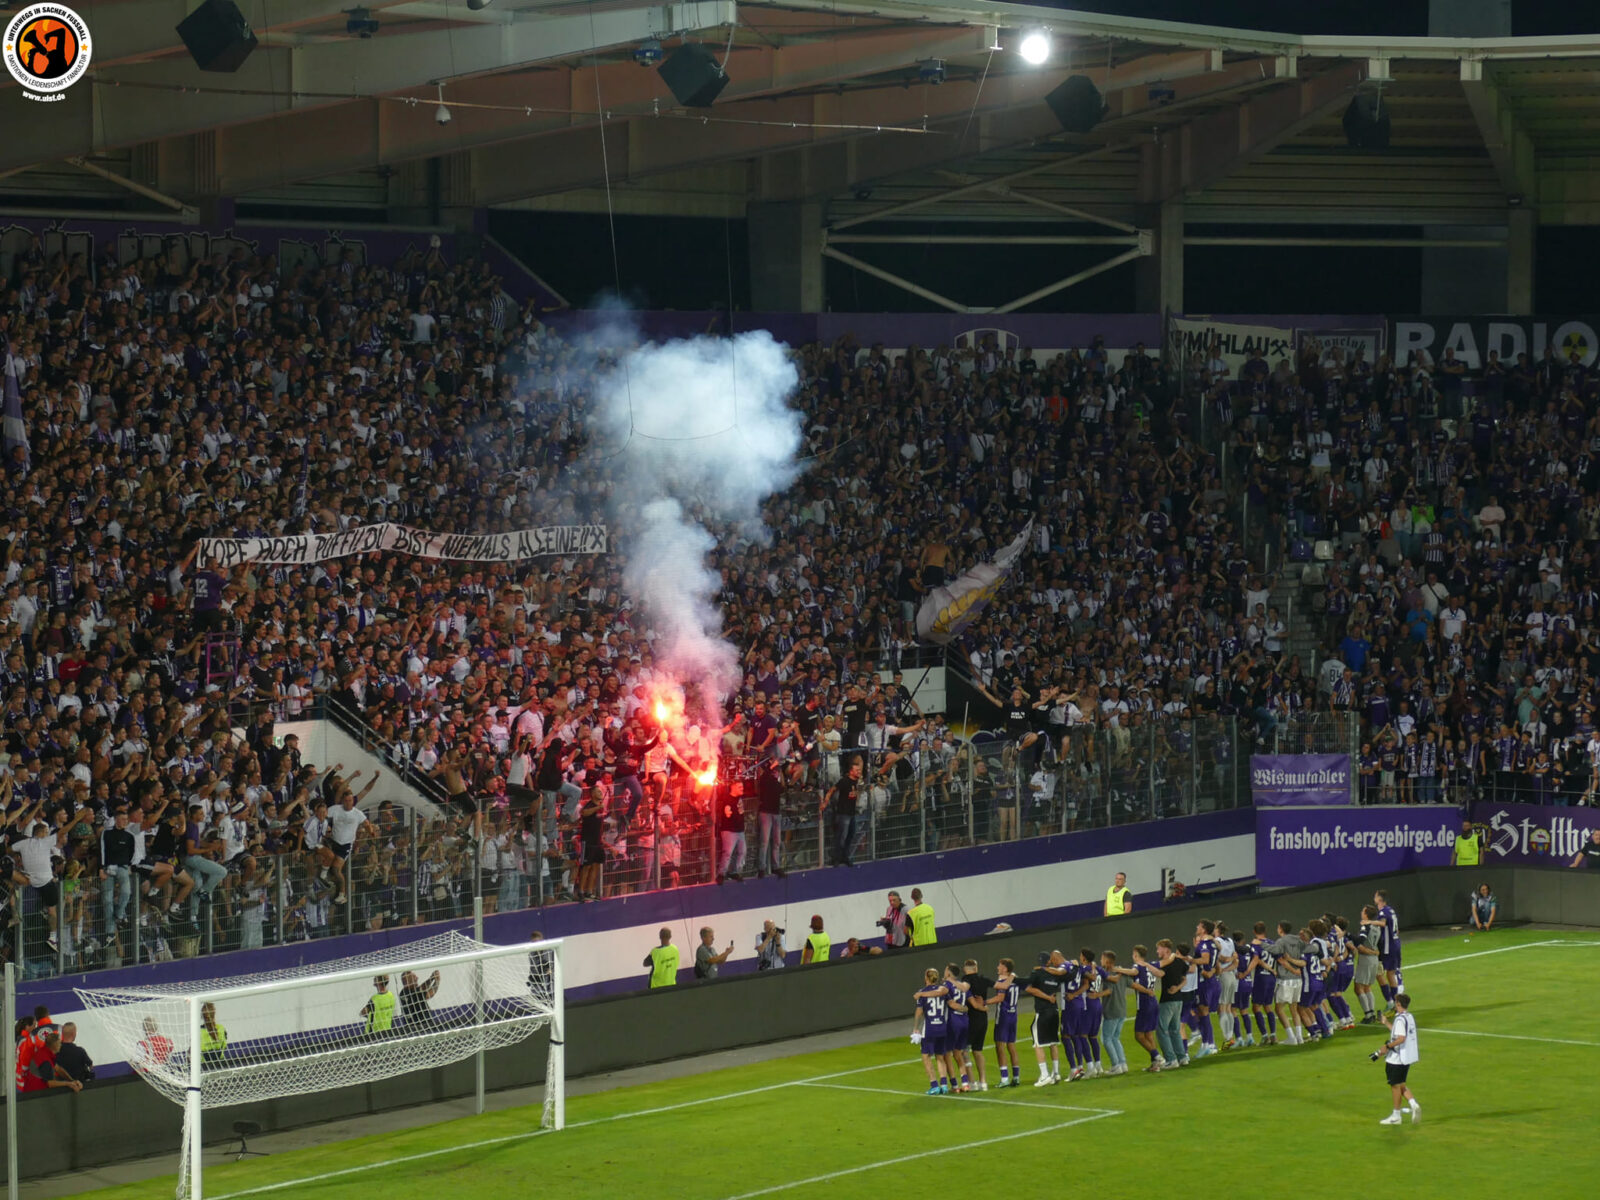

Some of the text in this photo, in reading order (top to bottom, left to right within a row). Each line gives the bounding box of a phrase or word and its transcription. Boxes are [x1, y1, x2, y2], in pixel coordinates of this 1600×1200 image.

[1188, 327, 1270, 357] MÜHLAU
[200, 538, 249, 567] KOPF
[256, 538, 308, 562] HOCH
[393, 526, 441, 554] BIST
[439, 535, 510, 560] NIEMALS
[1253, 768, 1346, 786] Wismutadler
[1269, 824, 1455, 856] fanshop.fc-erzgebirge.de
[927, 997, 945, 1016] 34
[1009, 986, 1019, 1006] 11
